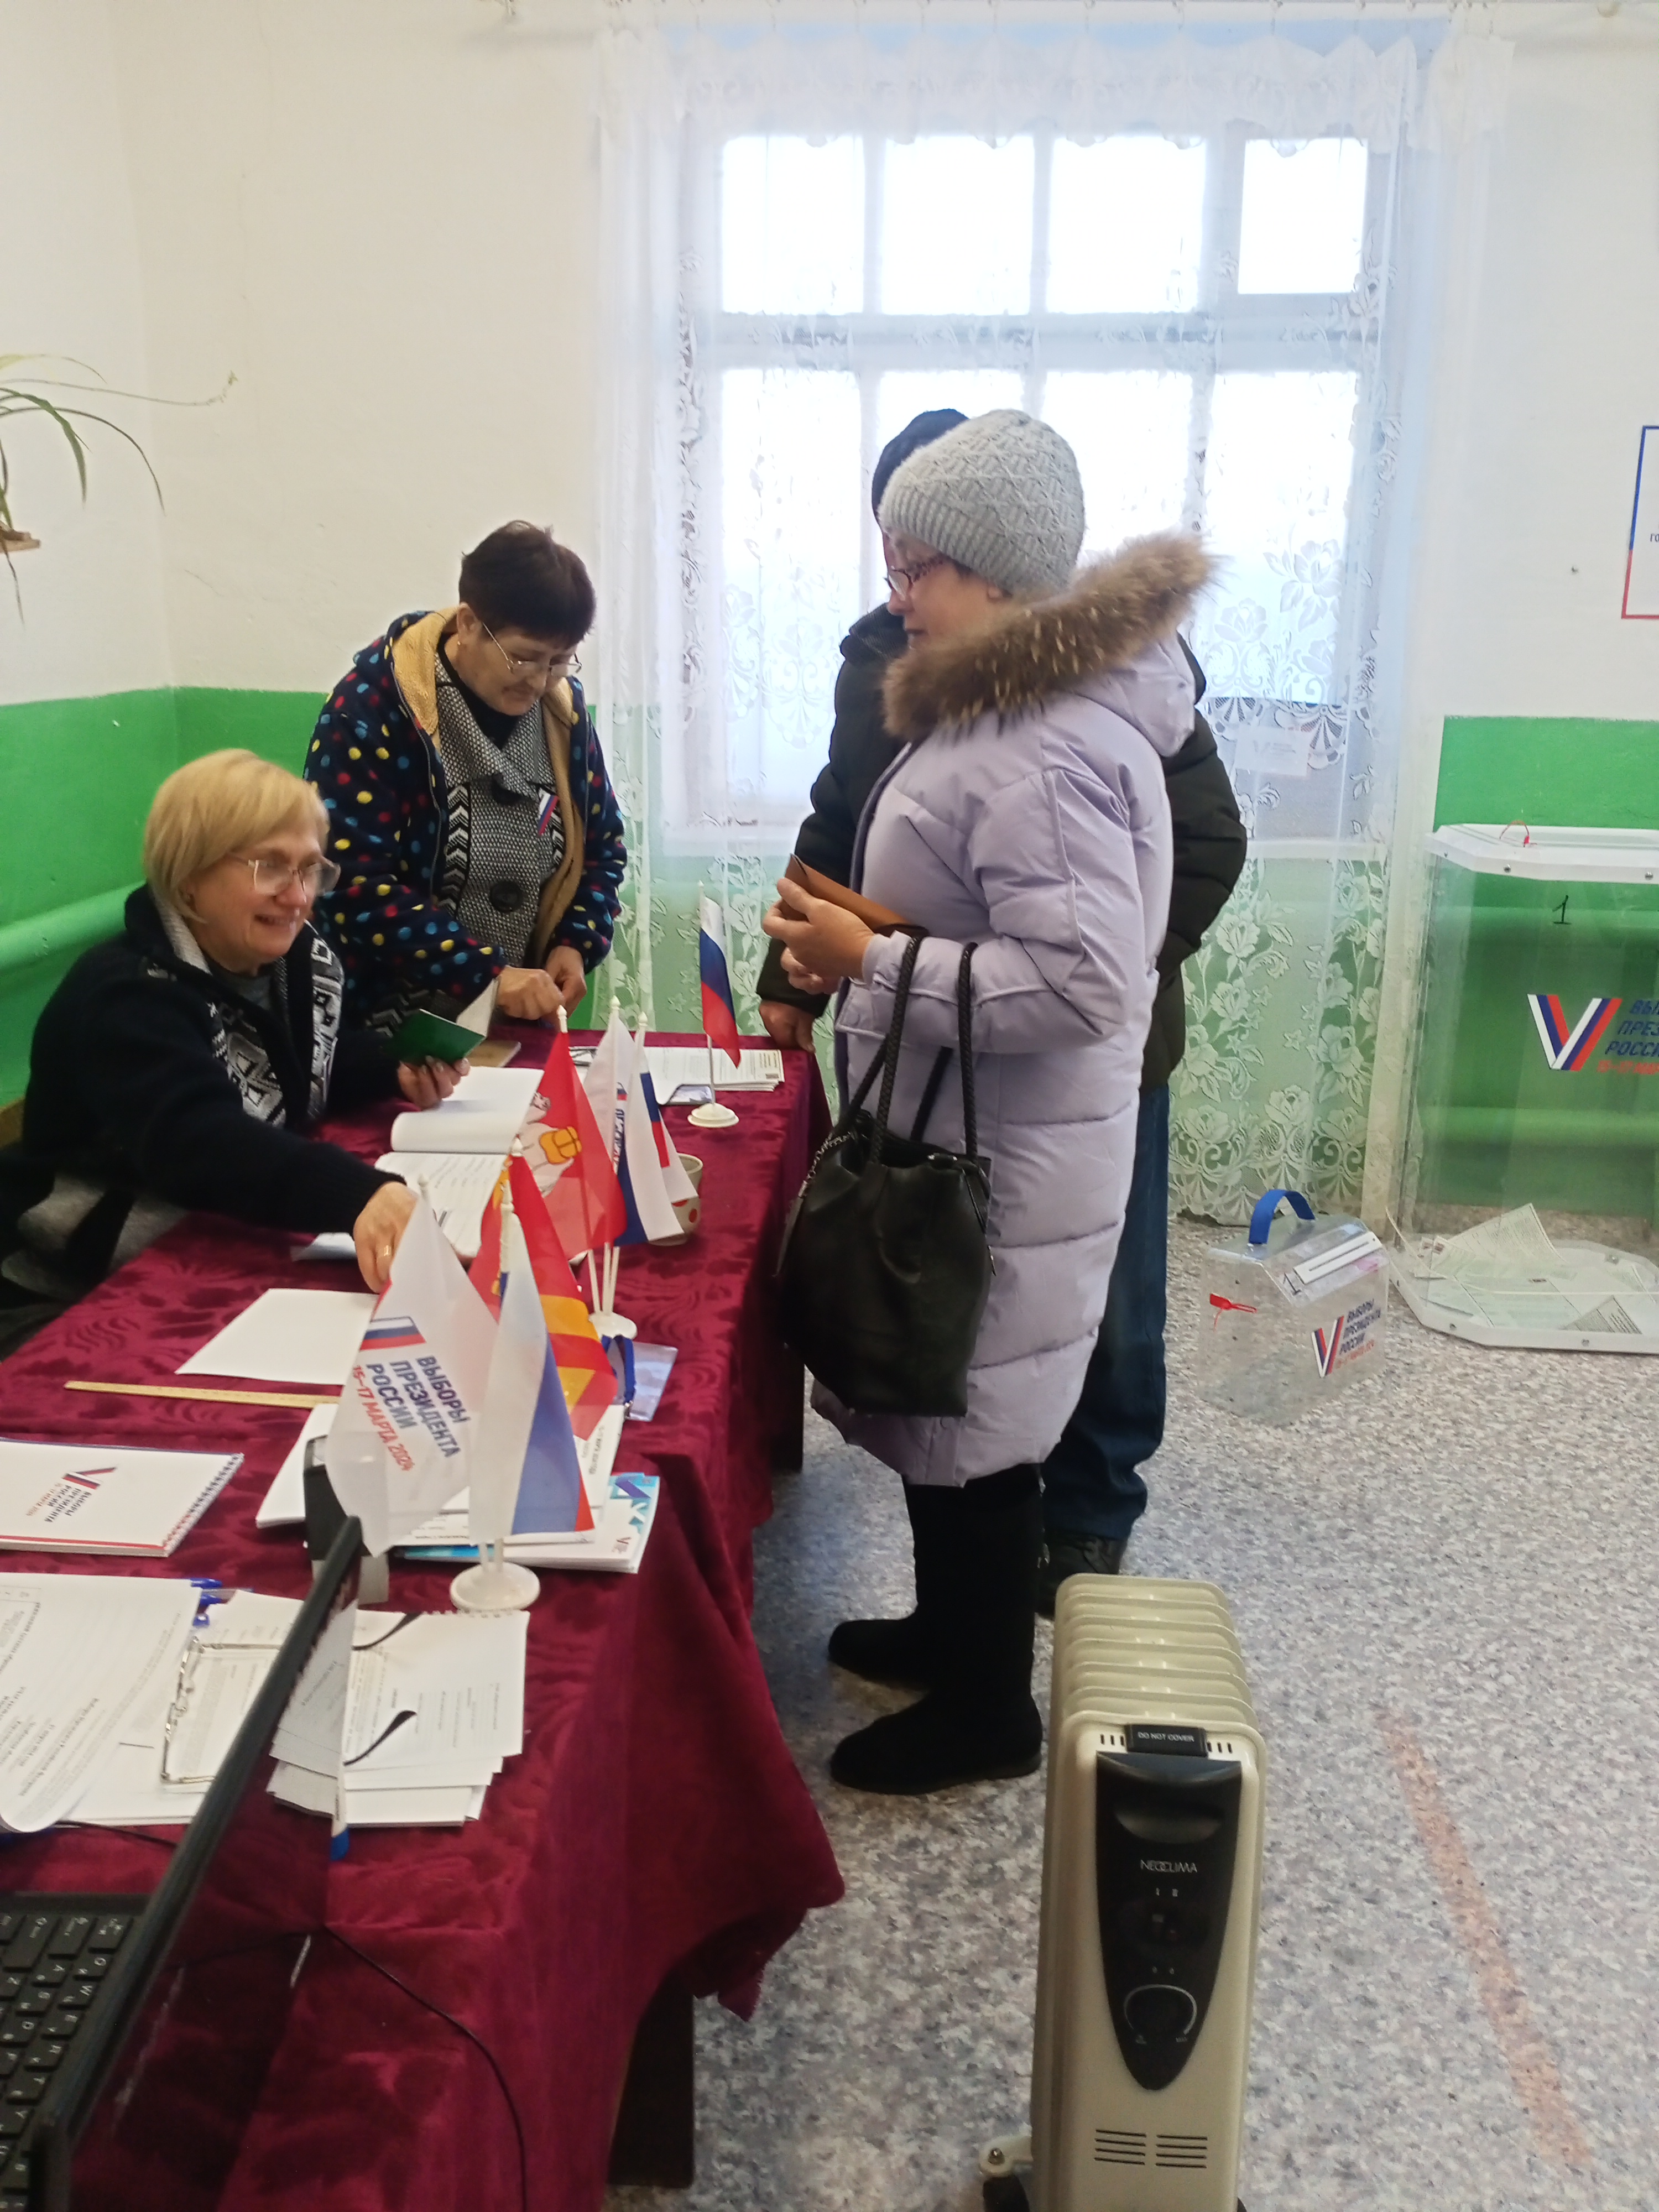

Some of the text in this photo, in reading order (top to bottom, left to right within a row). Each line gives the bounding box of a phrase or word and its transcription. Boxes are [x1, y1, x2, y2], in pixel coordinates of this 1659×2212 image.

[1552, 895, 1572, 925] 1
[366, 1363, 418, 1429] РОССИИ
[389, 1360, 461, 1458] ПРЕЗИДЕНТА
[416, 1355, 471, 1423] ВЫБОРЫ
[362, 1402, 399, 1444] МАРТА
[1150, 1733, 1166, 1741] NOT
[1167, 1734, 1194, 1743] COVER
